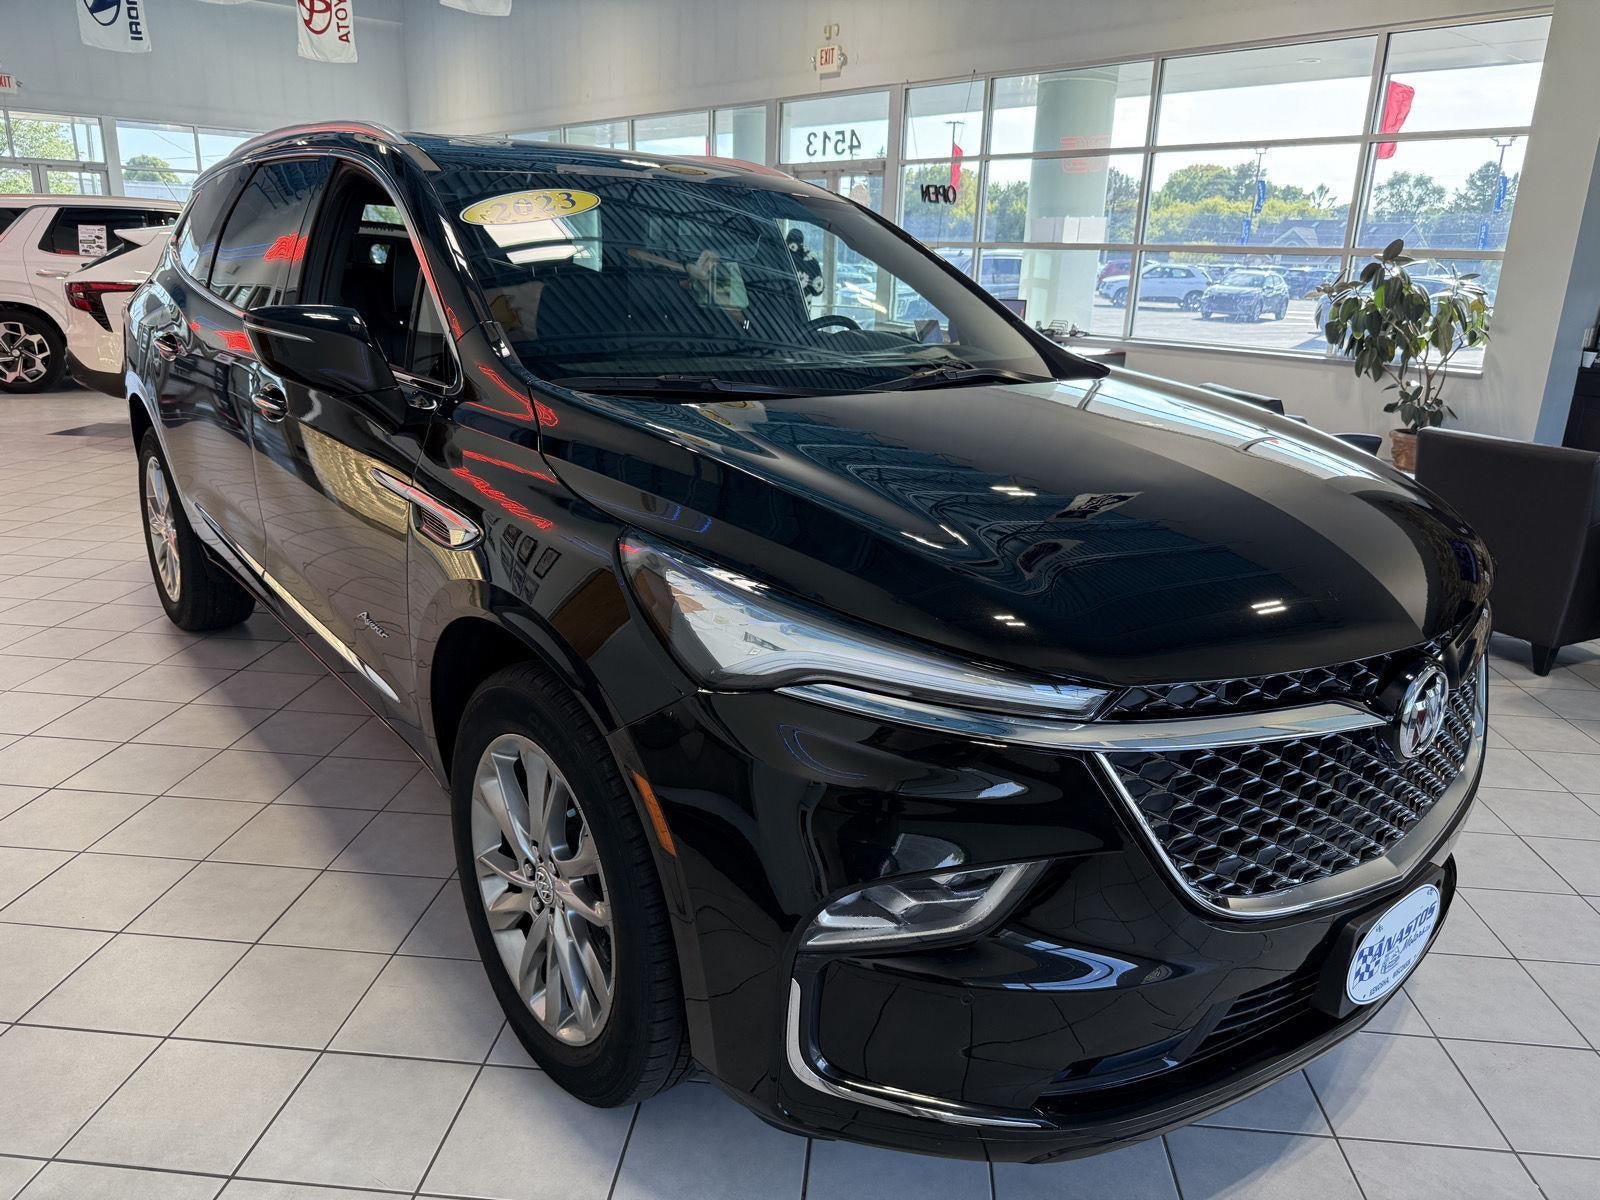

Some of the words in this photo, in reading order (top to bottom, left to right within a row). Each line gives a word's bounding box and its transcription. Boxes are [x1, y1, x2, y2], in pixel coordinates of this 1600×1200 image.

[820, 47, 835, 66] EXIT
[489, 192, 577, 222] 2023
[1371, 901, 1438, 963] ANASTOS
